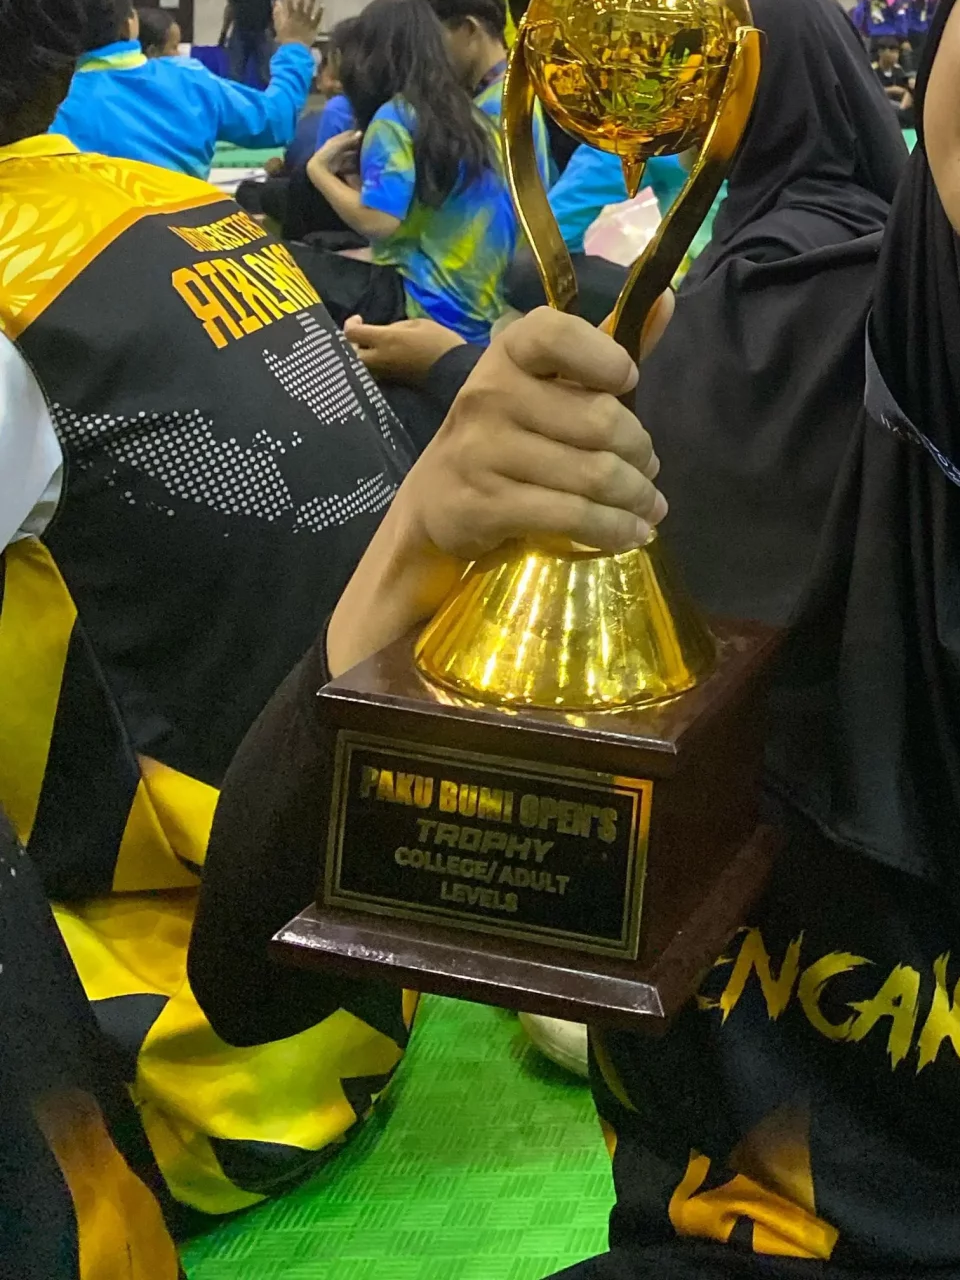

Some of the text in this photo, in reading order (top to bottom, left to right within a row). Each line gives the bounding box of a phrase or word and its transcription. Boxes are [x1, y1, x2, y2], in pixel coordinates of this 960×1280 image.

[361, 765, 619, 845] PAKU BUMI OPEN'S
[415, 818, 556, 864] TROPHY
[439, 881, 519, 913] LEVELS
